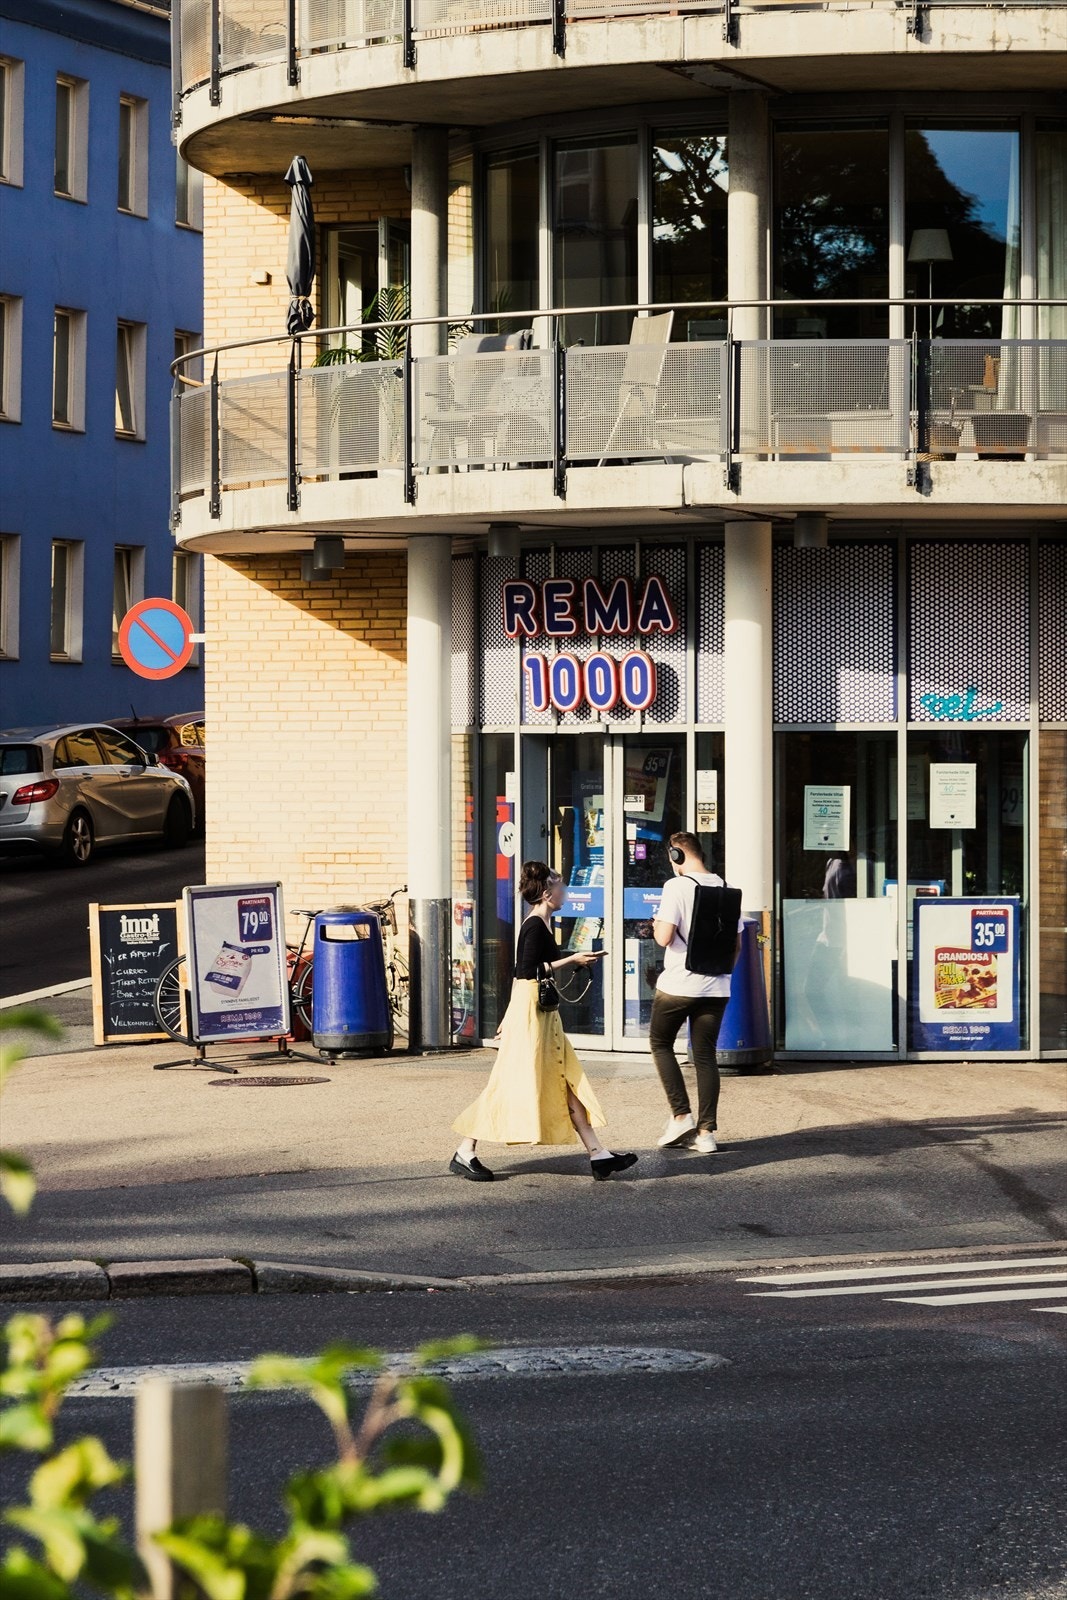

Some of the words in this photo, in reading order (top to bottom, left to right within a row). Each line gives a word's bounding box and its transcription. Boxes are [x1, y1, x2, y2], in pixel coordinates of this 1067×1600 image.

[502, 576, 680, 637] REMA
[522, 650, 657, 712] 1000
[645, 757, 658, 772] 35
[652, 905, 660, 913] 7-
[937, 953, 989, 961] GRANDIOSA
[942, 1026, 969, 1034] REMA
